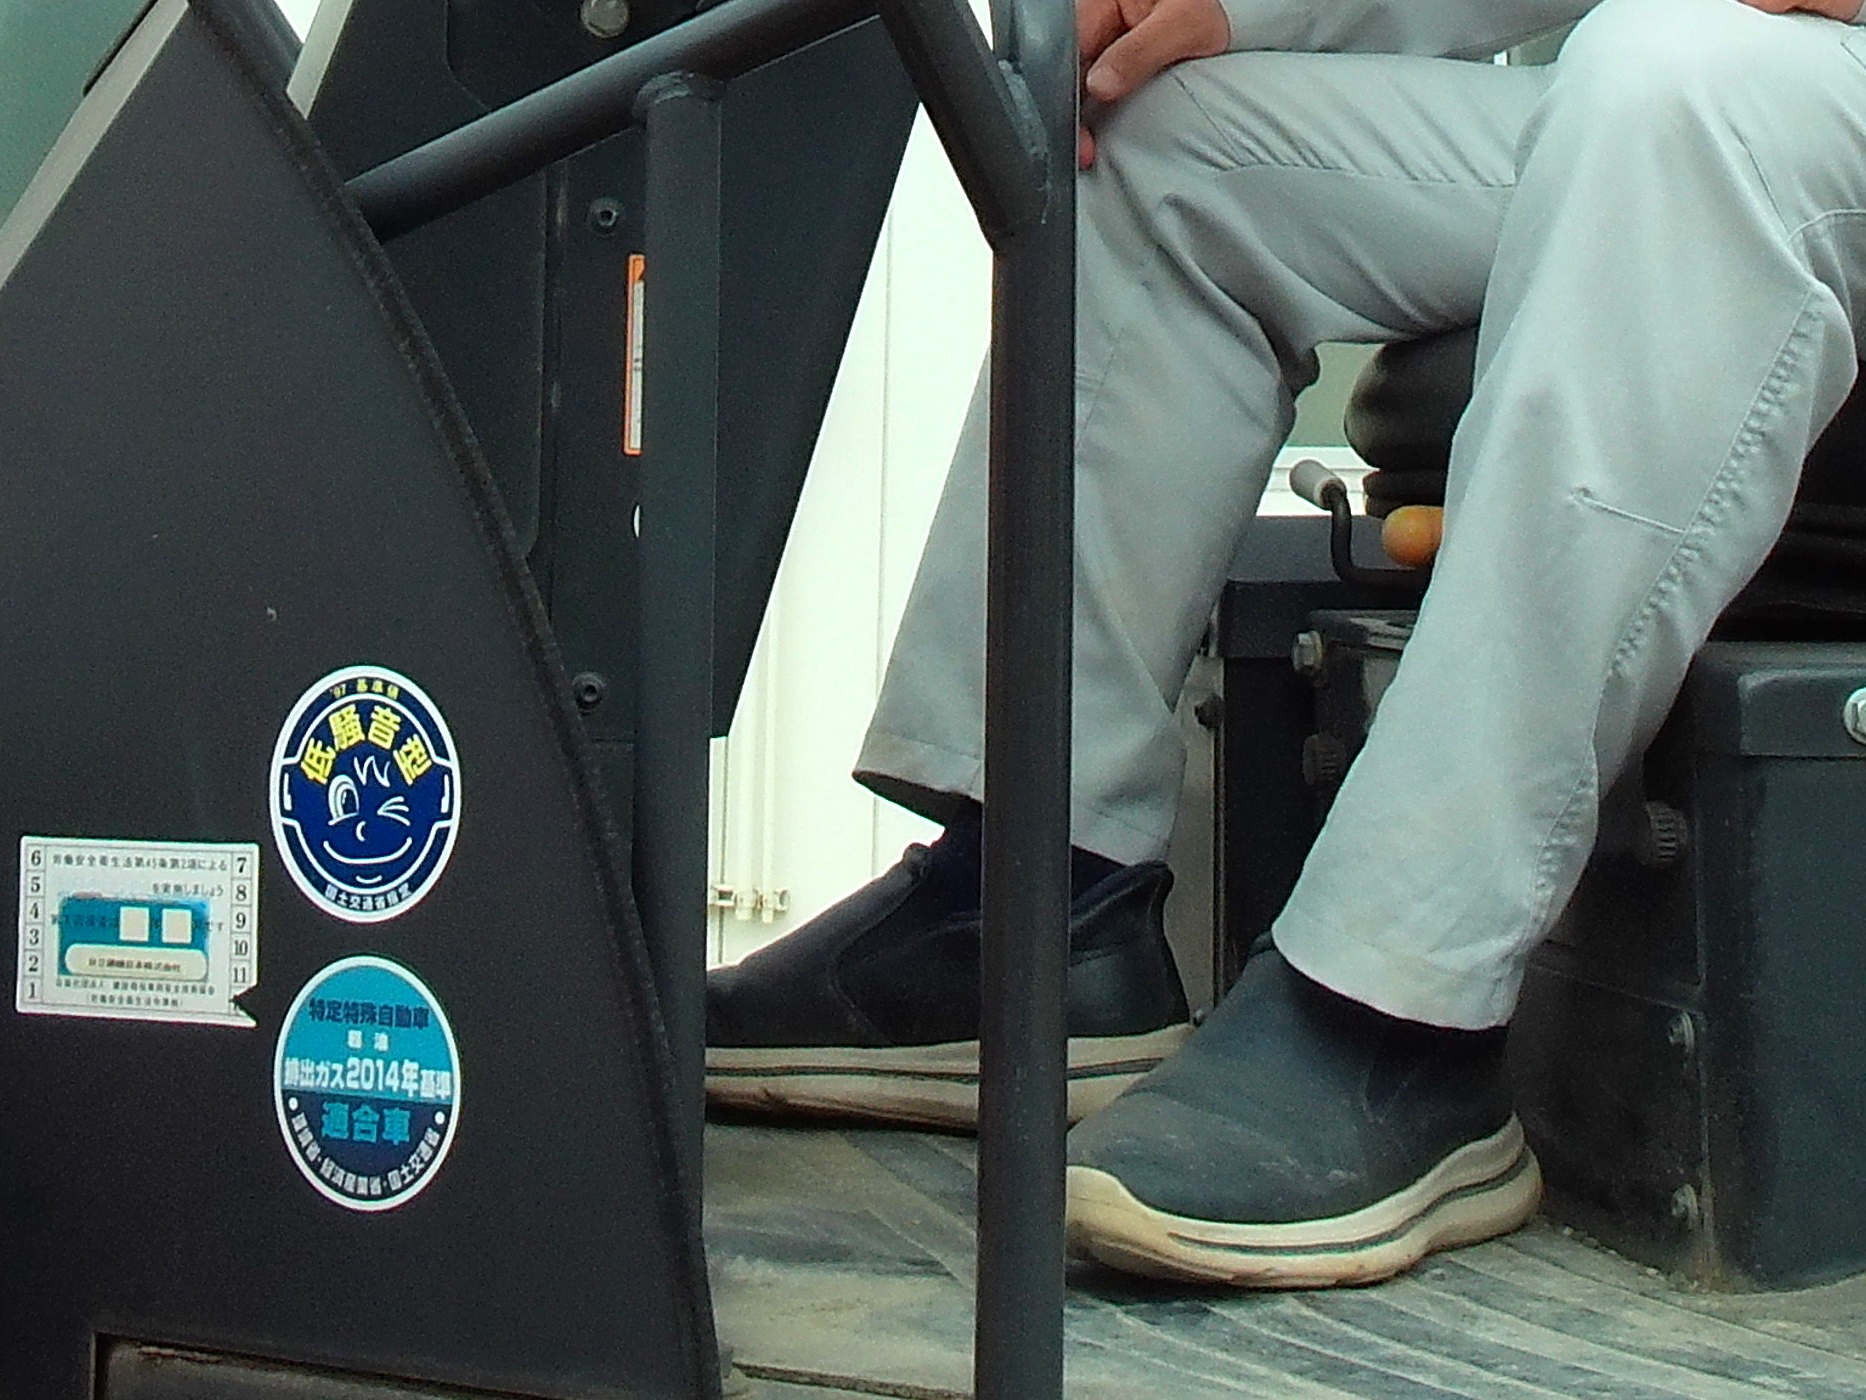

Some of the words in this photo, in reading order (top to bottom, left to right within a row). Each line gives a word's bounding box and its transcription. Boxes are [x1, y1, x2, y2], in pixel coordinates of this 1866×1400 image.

[300, 703, 433, 786] 低騒音型
[31, 850, 41, 866] 6
[236, 857, 247, 873] 7
[31, 877, 41, 894] 5
[236, 884, 247, 901] 8
[30, 902, 39, 919] 4
[235, 912, 247, 929] 9
[30, 929, 39, 945] 3
[234, 941, 248, 957] 10
[29, 956, 39, 972] 2
[233, 967, 247, 983] 11
[28, 983, 37, 999] 1
[309, 998, 430, 1030] 特定特殊自動車
[321, 1101, 412, 1147] 適合車
